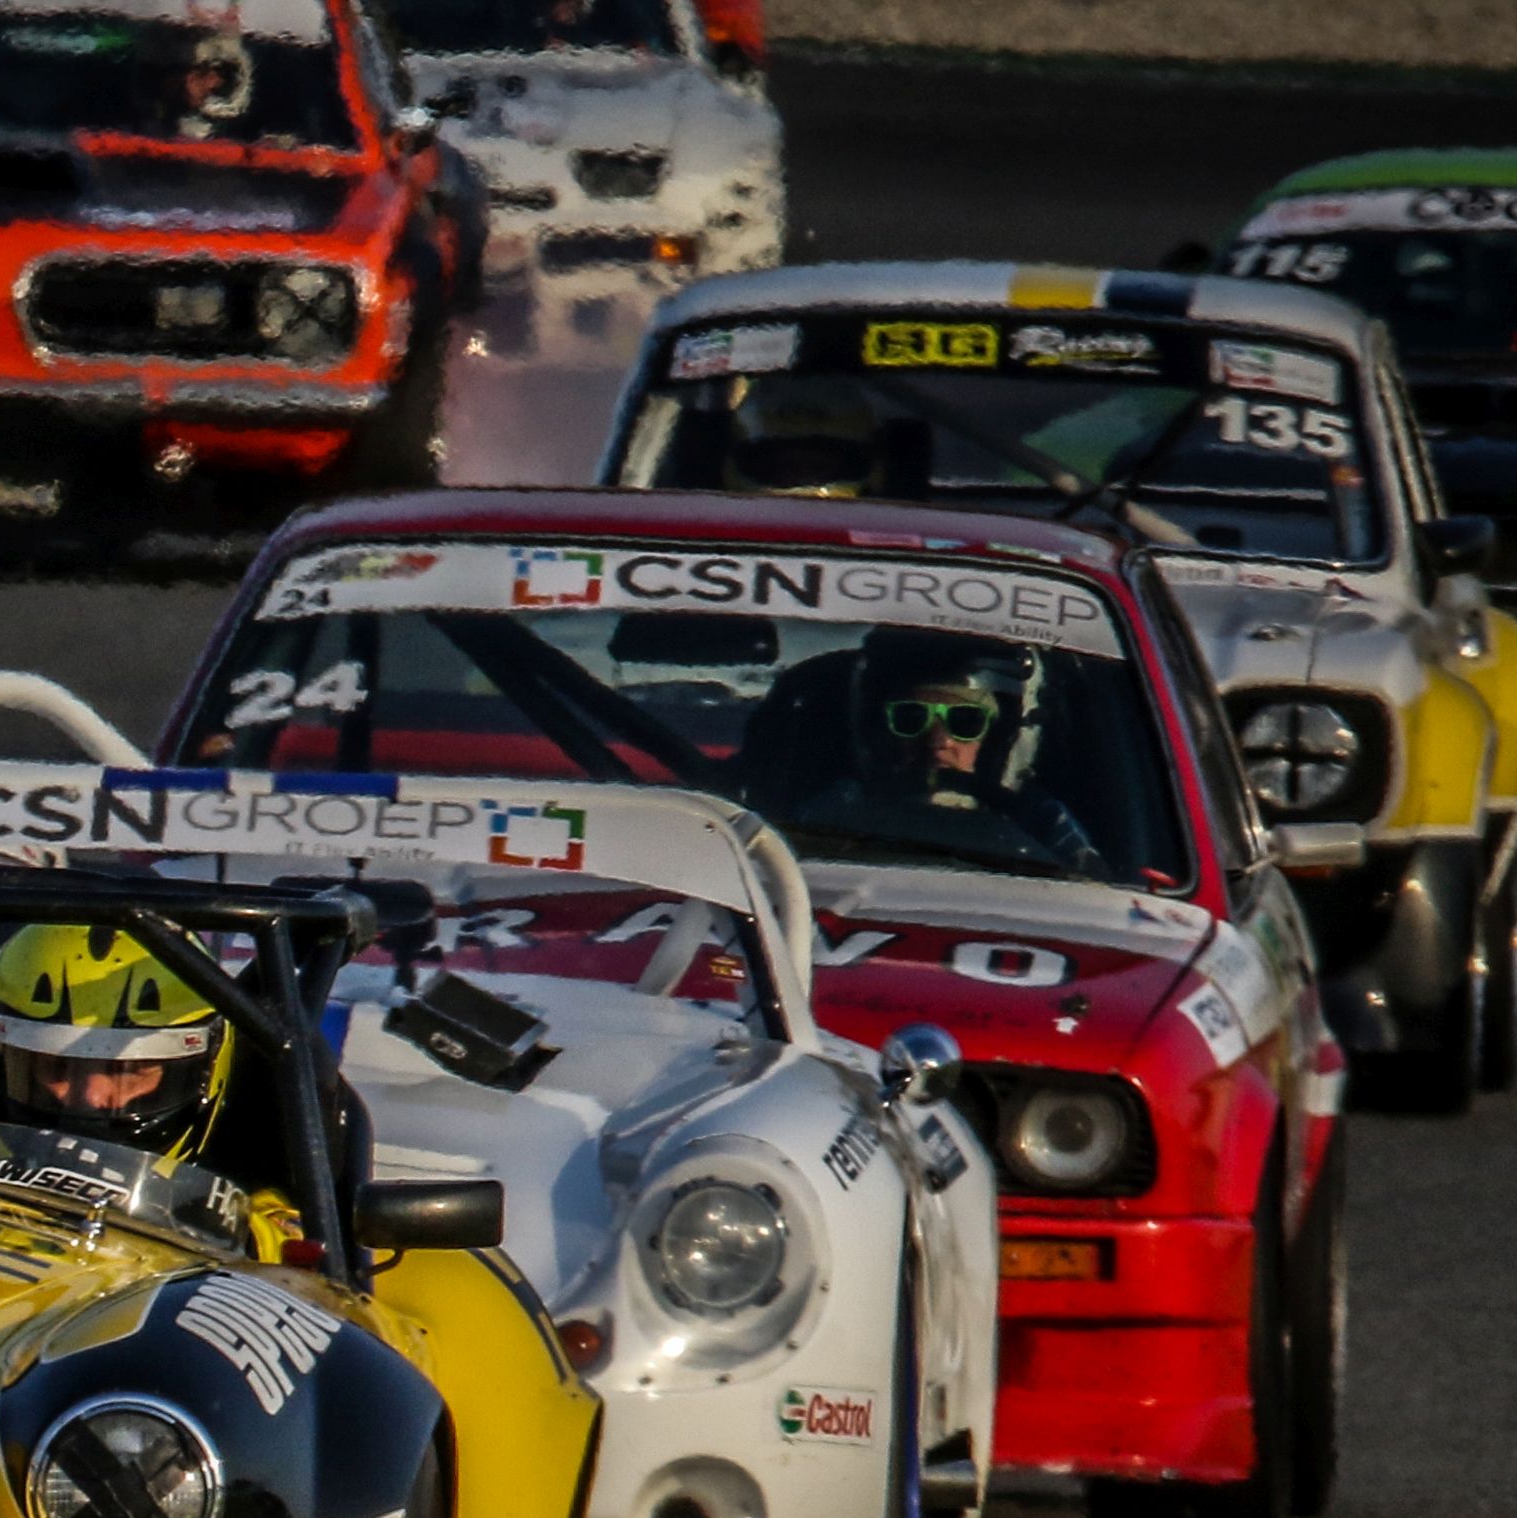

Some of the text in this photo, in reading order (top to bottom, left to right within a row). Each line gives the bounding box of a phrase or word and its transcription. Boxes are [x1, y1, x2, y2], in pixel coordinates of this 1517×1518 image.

[1231, 243, 1349, 283] 115
[1204, 397, 1353, 459] 135
[225, 659, 367, 728] 24
[807, 1393, 872, 1438] Castrol
